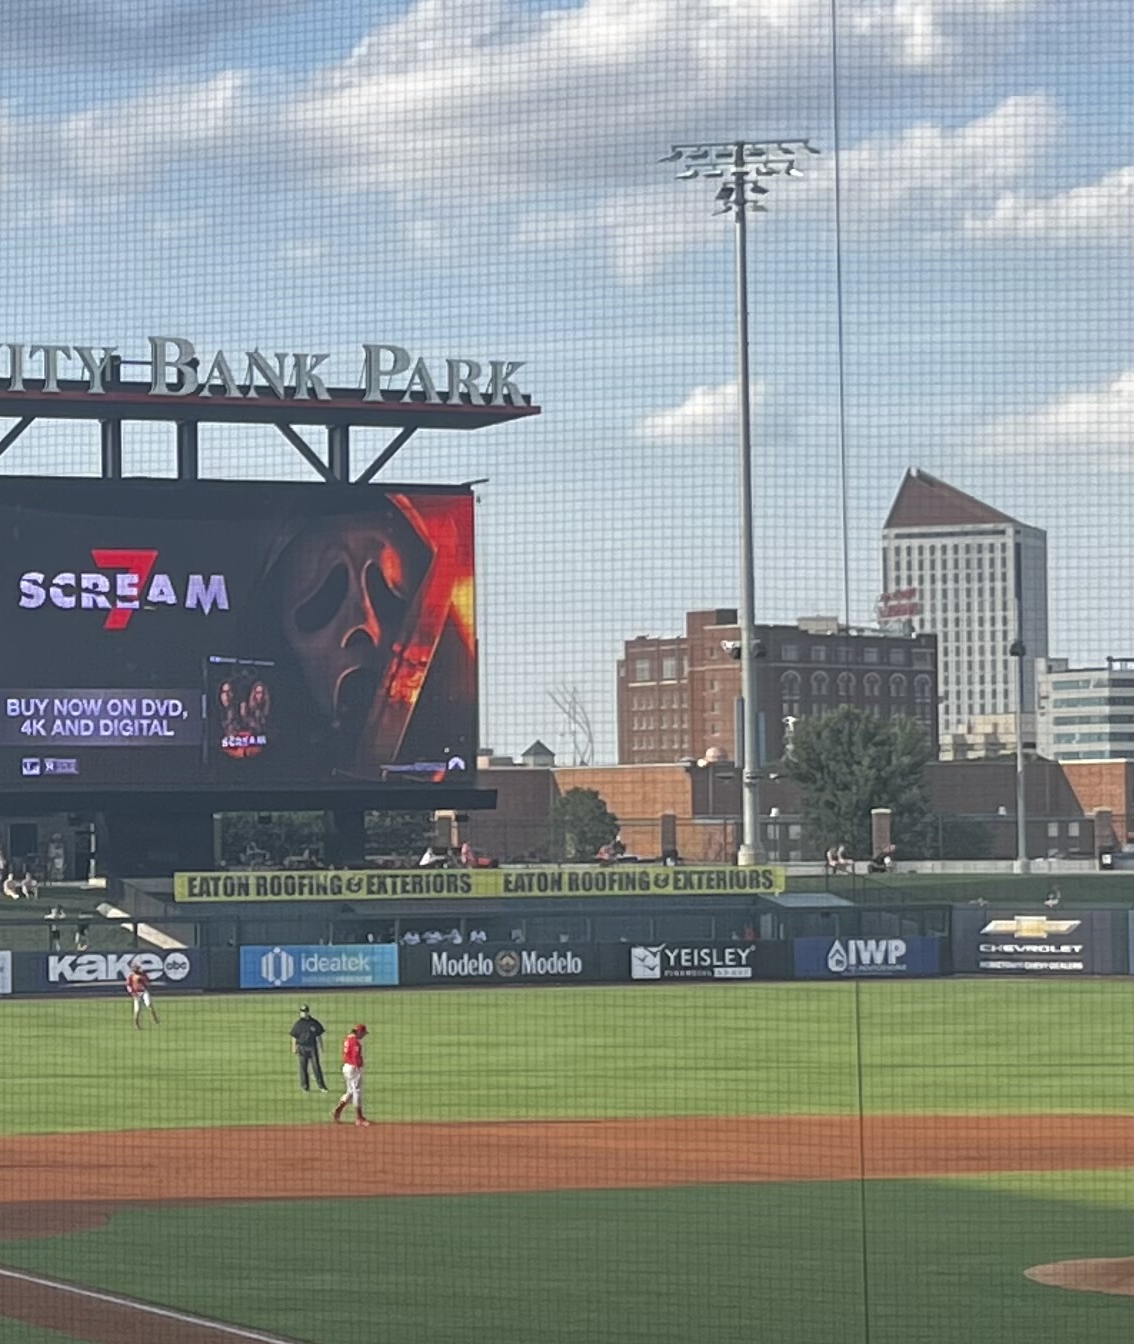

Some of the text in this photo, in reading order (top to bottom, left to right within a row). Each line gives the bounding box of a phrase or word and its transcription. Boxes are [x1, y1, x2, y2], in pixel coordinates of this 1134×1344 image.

[147, 335, 332, 402] BANK
[362, 343, 529, 407] PARK
[17, 571, 231, 617] SCREAM
[6, 698, 189, 719] BUY NOW ON DVD,
[21, 719, 175, 737] 4K AND DIGITAL
[187, 873, 472, 897] EATON ROOFING & EXTERIORS
[503, 869, 774, 893] EATON ROOFING & EXTERIORS
[663, 948, 750, 966] YEISLEY
[847, 939, 907, 965] IWP
[979, 944, 1083, 953] CHEVROLET
[166, 960, 188, 971] abc
[300, 952, 371, 972] ideatek
[431, 950, 583, 976] Modelo Modelo
